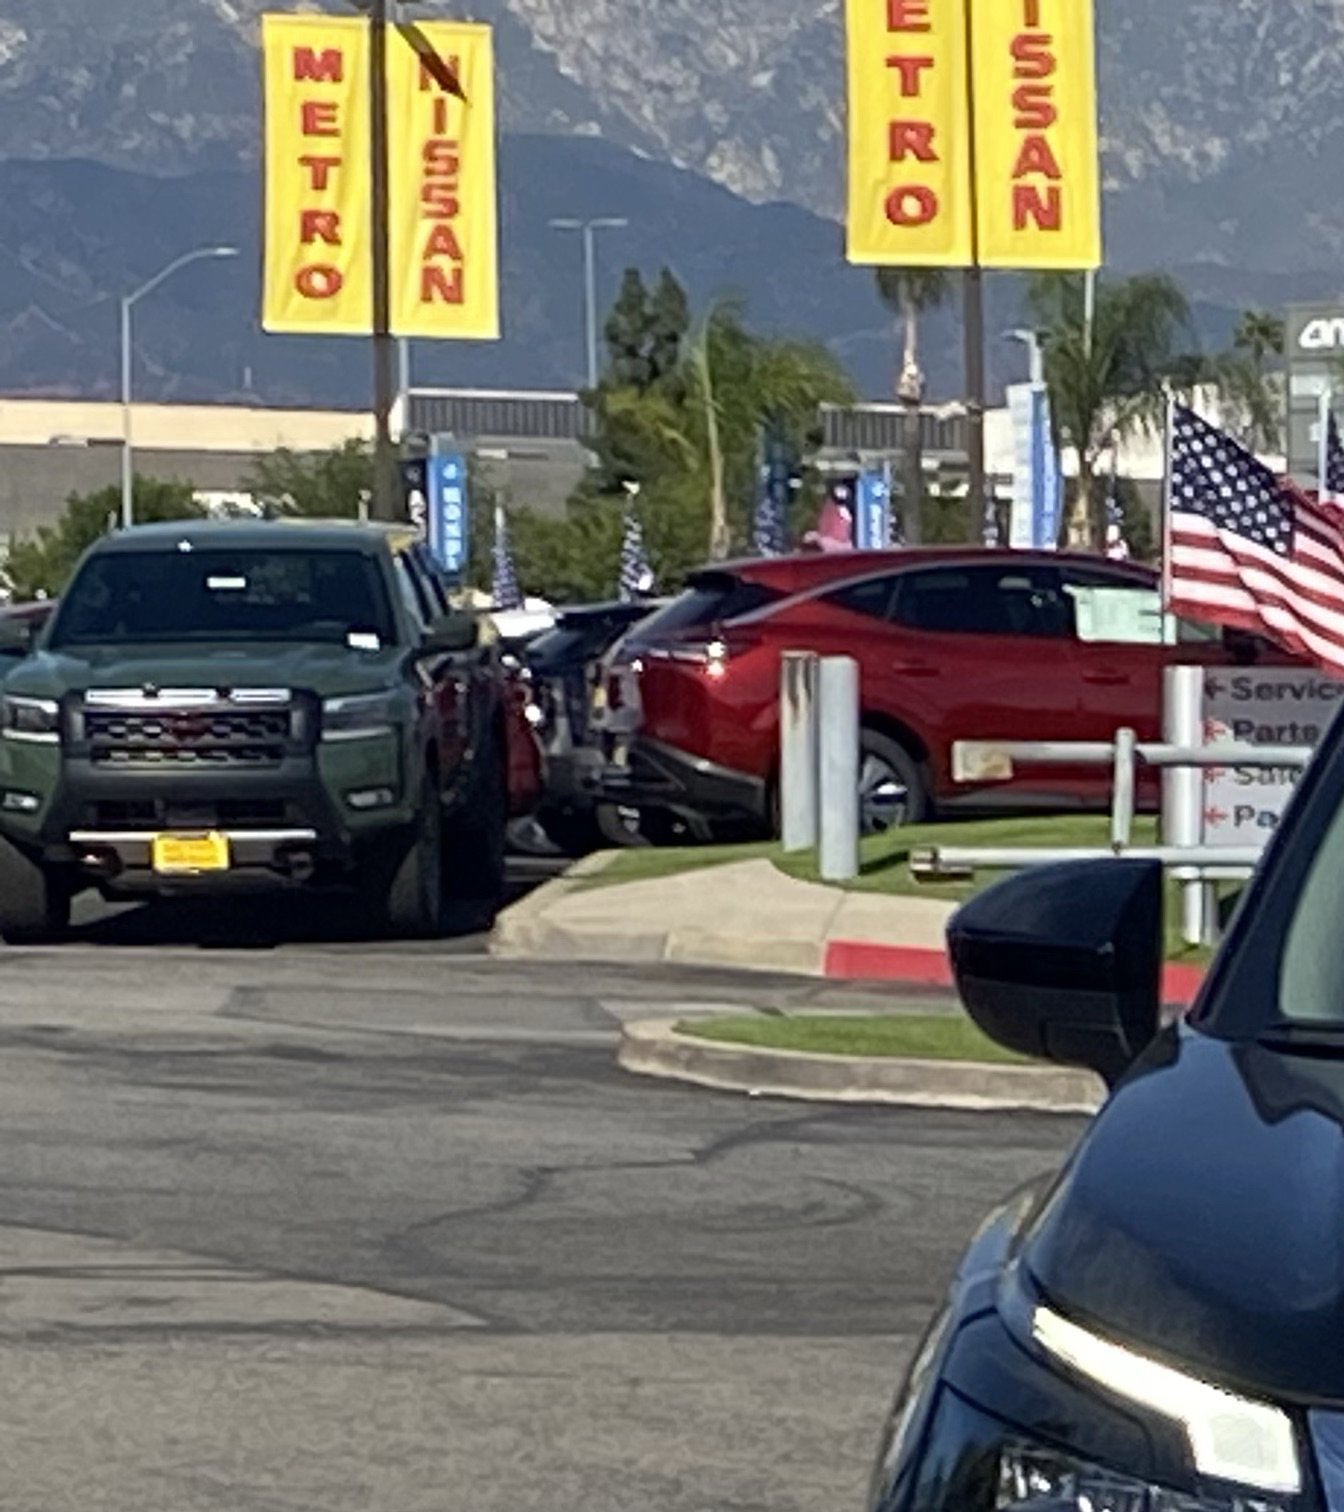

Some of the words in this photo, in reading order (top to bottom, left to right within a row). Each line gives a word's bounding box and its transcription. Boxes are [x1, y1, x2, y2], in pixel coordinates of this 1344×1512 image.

[292, 47, 344, 299] METRO
[419, 53, 467, 305] NISSAN
[1232, 719, 1318, 744] Parts
